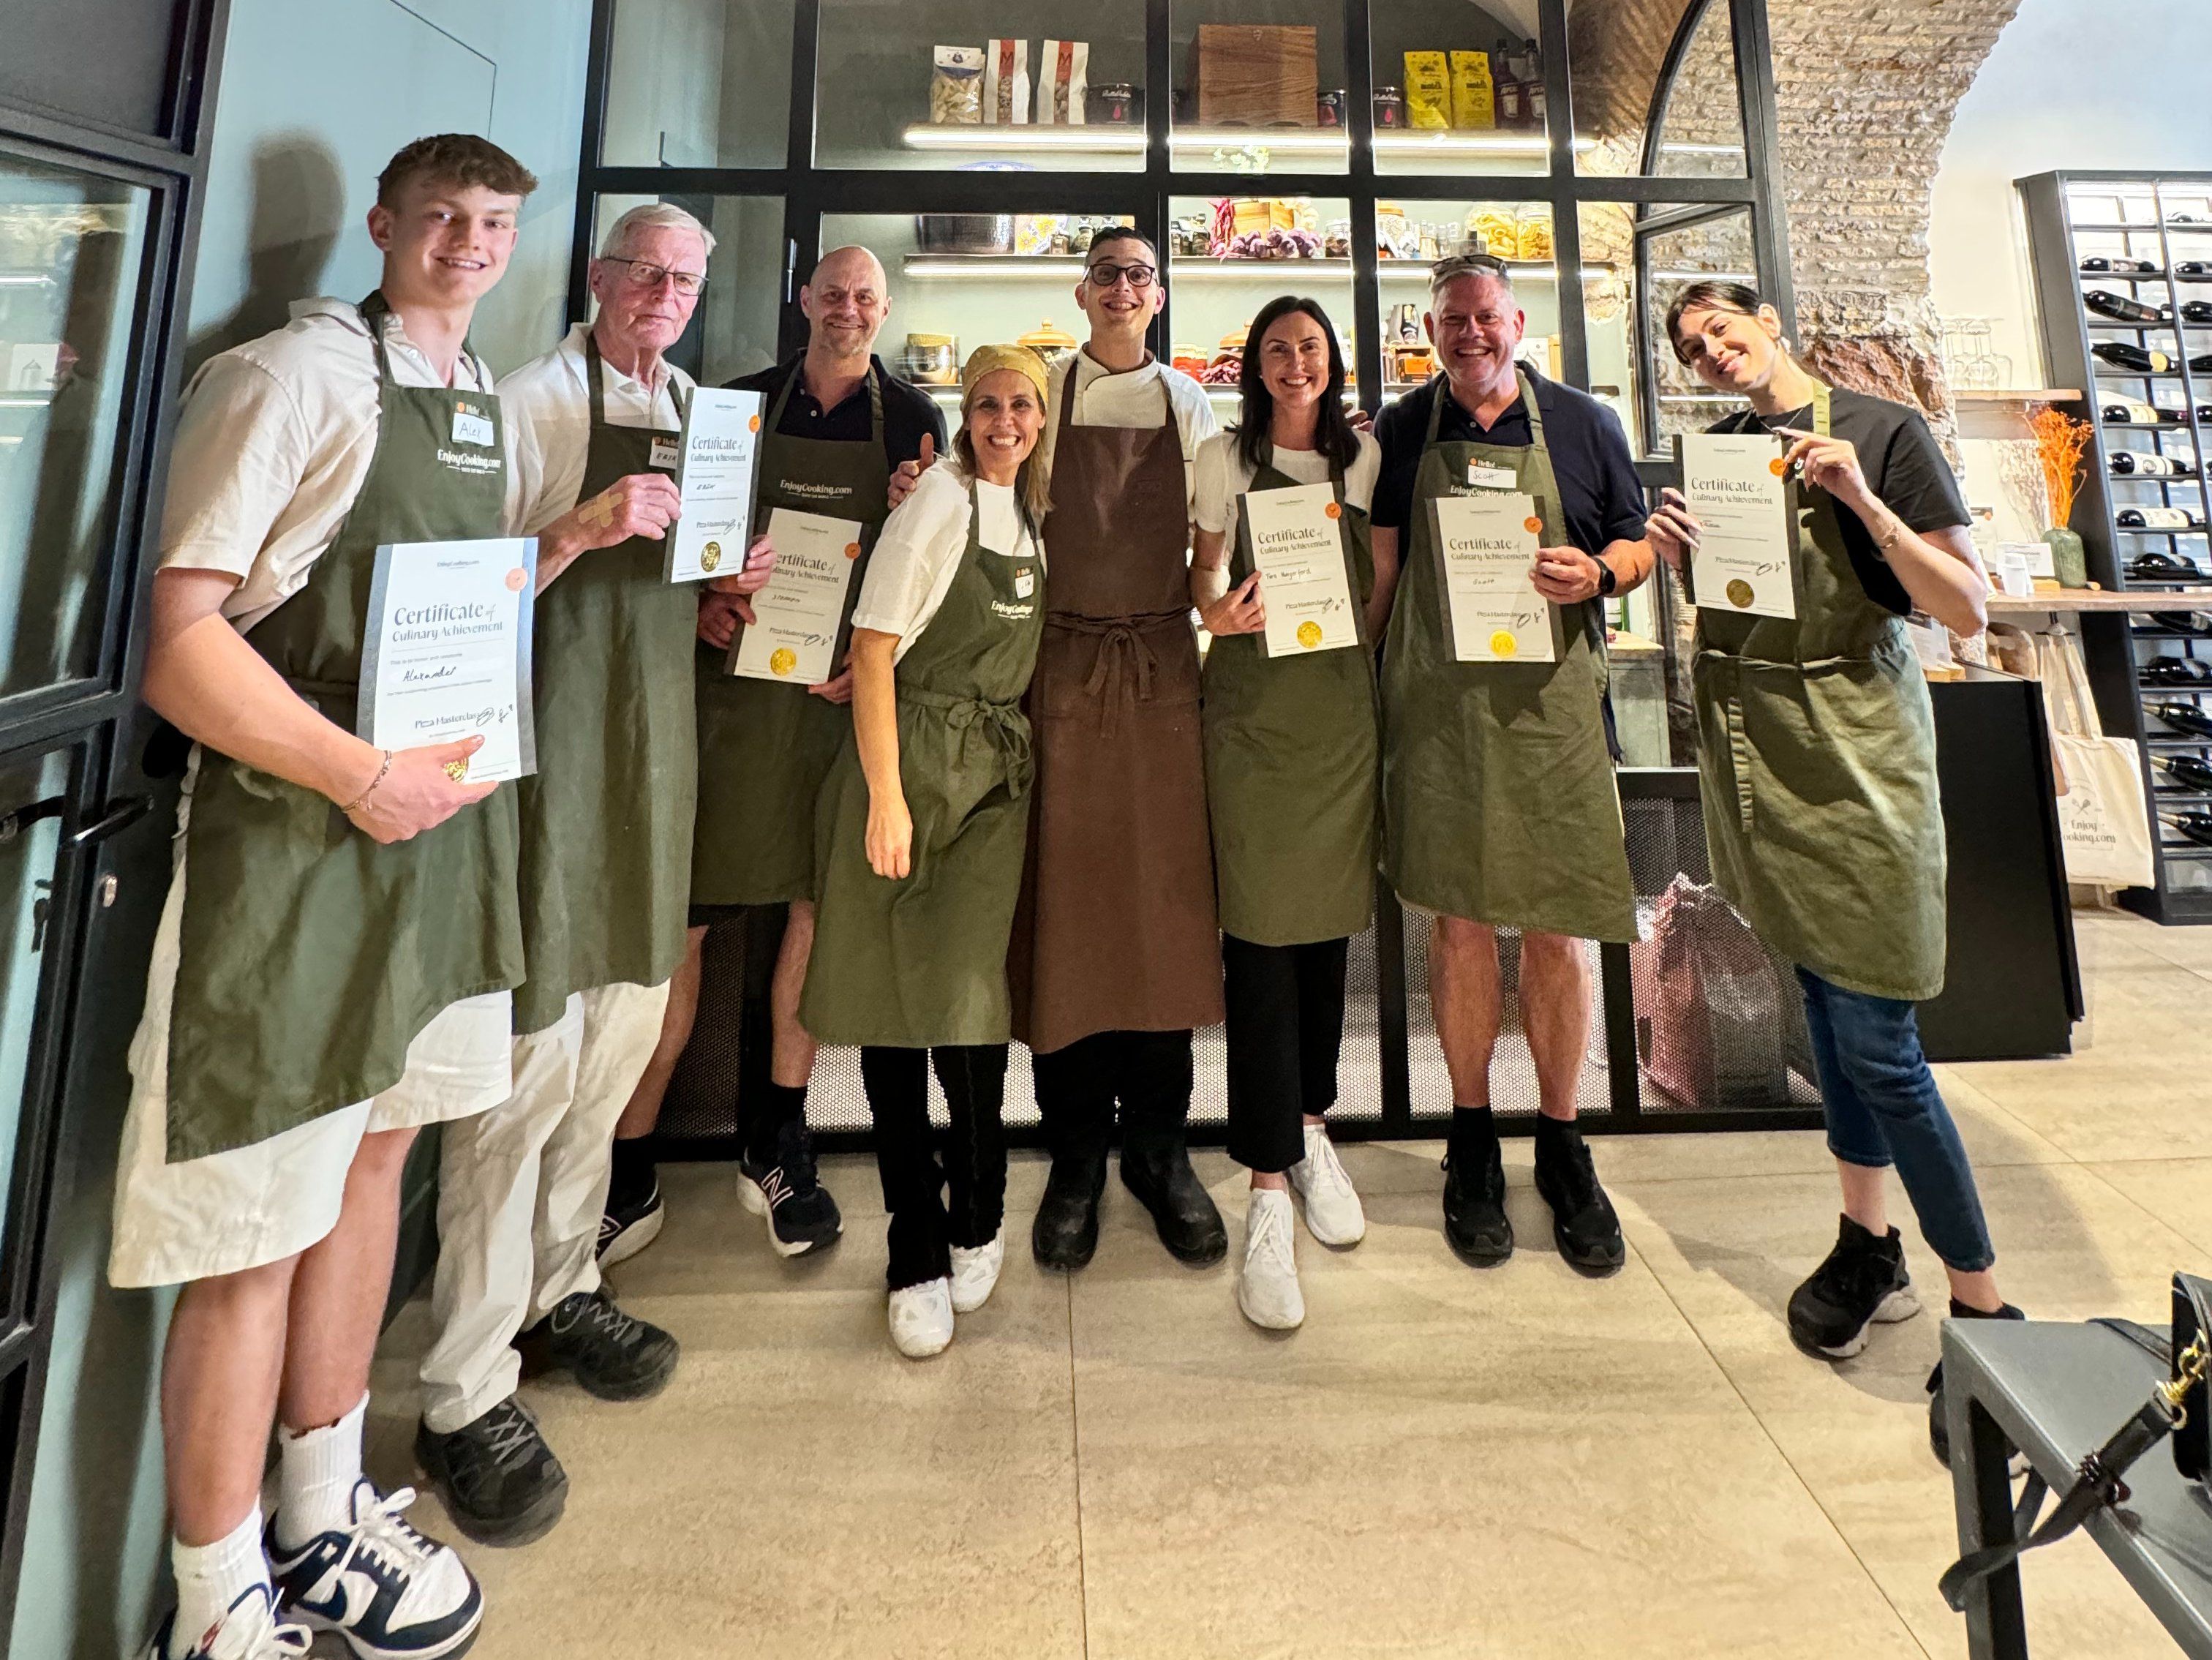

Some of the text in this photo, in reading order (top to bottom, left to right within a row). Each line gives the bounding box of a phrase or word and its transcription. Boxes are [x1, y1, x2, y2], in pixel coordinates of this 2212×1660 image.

[459, 422, 481, 439] Alex
[692, 436, 737, 450] Certificate
[437, 448, 501, 469] EnjoyCooking.com
[780, 479, 852, 495] EnjoyCooking.com
[1450, 484, 1523, 497] EnjoyCooking.com
[1691, 477, 1755, 492] Certificate
[1692, 493, 1773, 505] Culinary Achievement
[1257, 527, 1316, 544] Certificate
[1260, 539, 1332, 555] Culinary Achievement
[1449, 538, 1513, 550] Certificate
[776, 553, 827, 571] ertificate
[1451, 552, 1530, 562] Culinary Achievement
[394, 602, 484, 626] Certificate
[392, 621, 503, 642] Culinary Achievement
[2071, 819, 2098, 833] Enjoy
[2063, 832, 2116, 844] ooking.com
